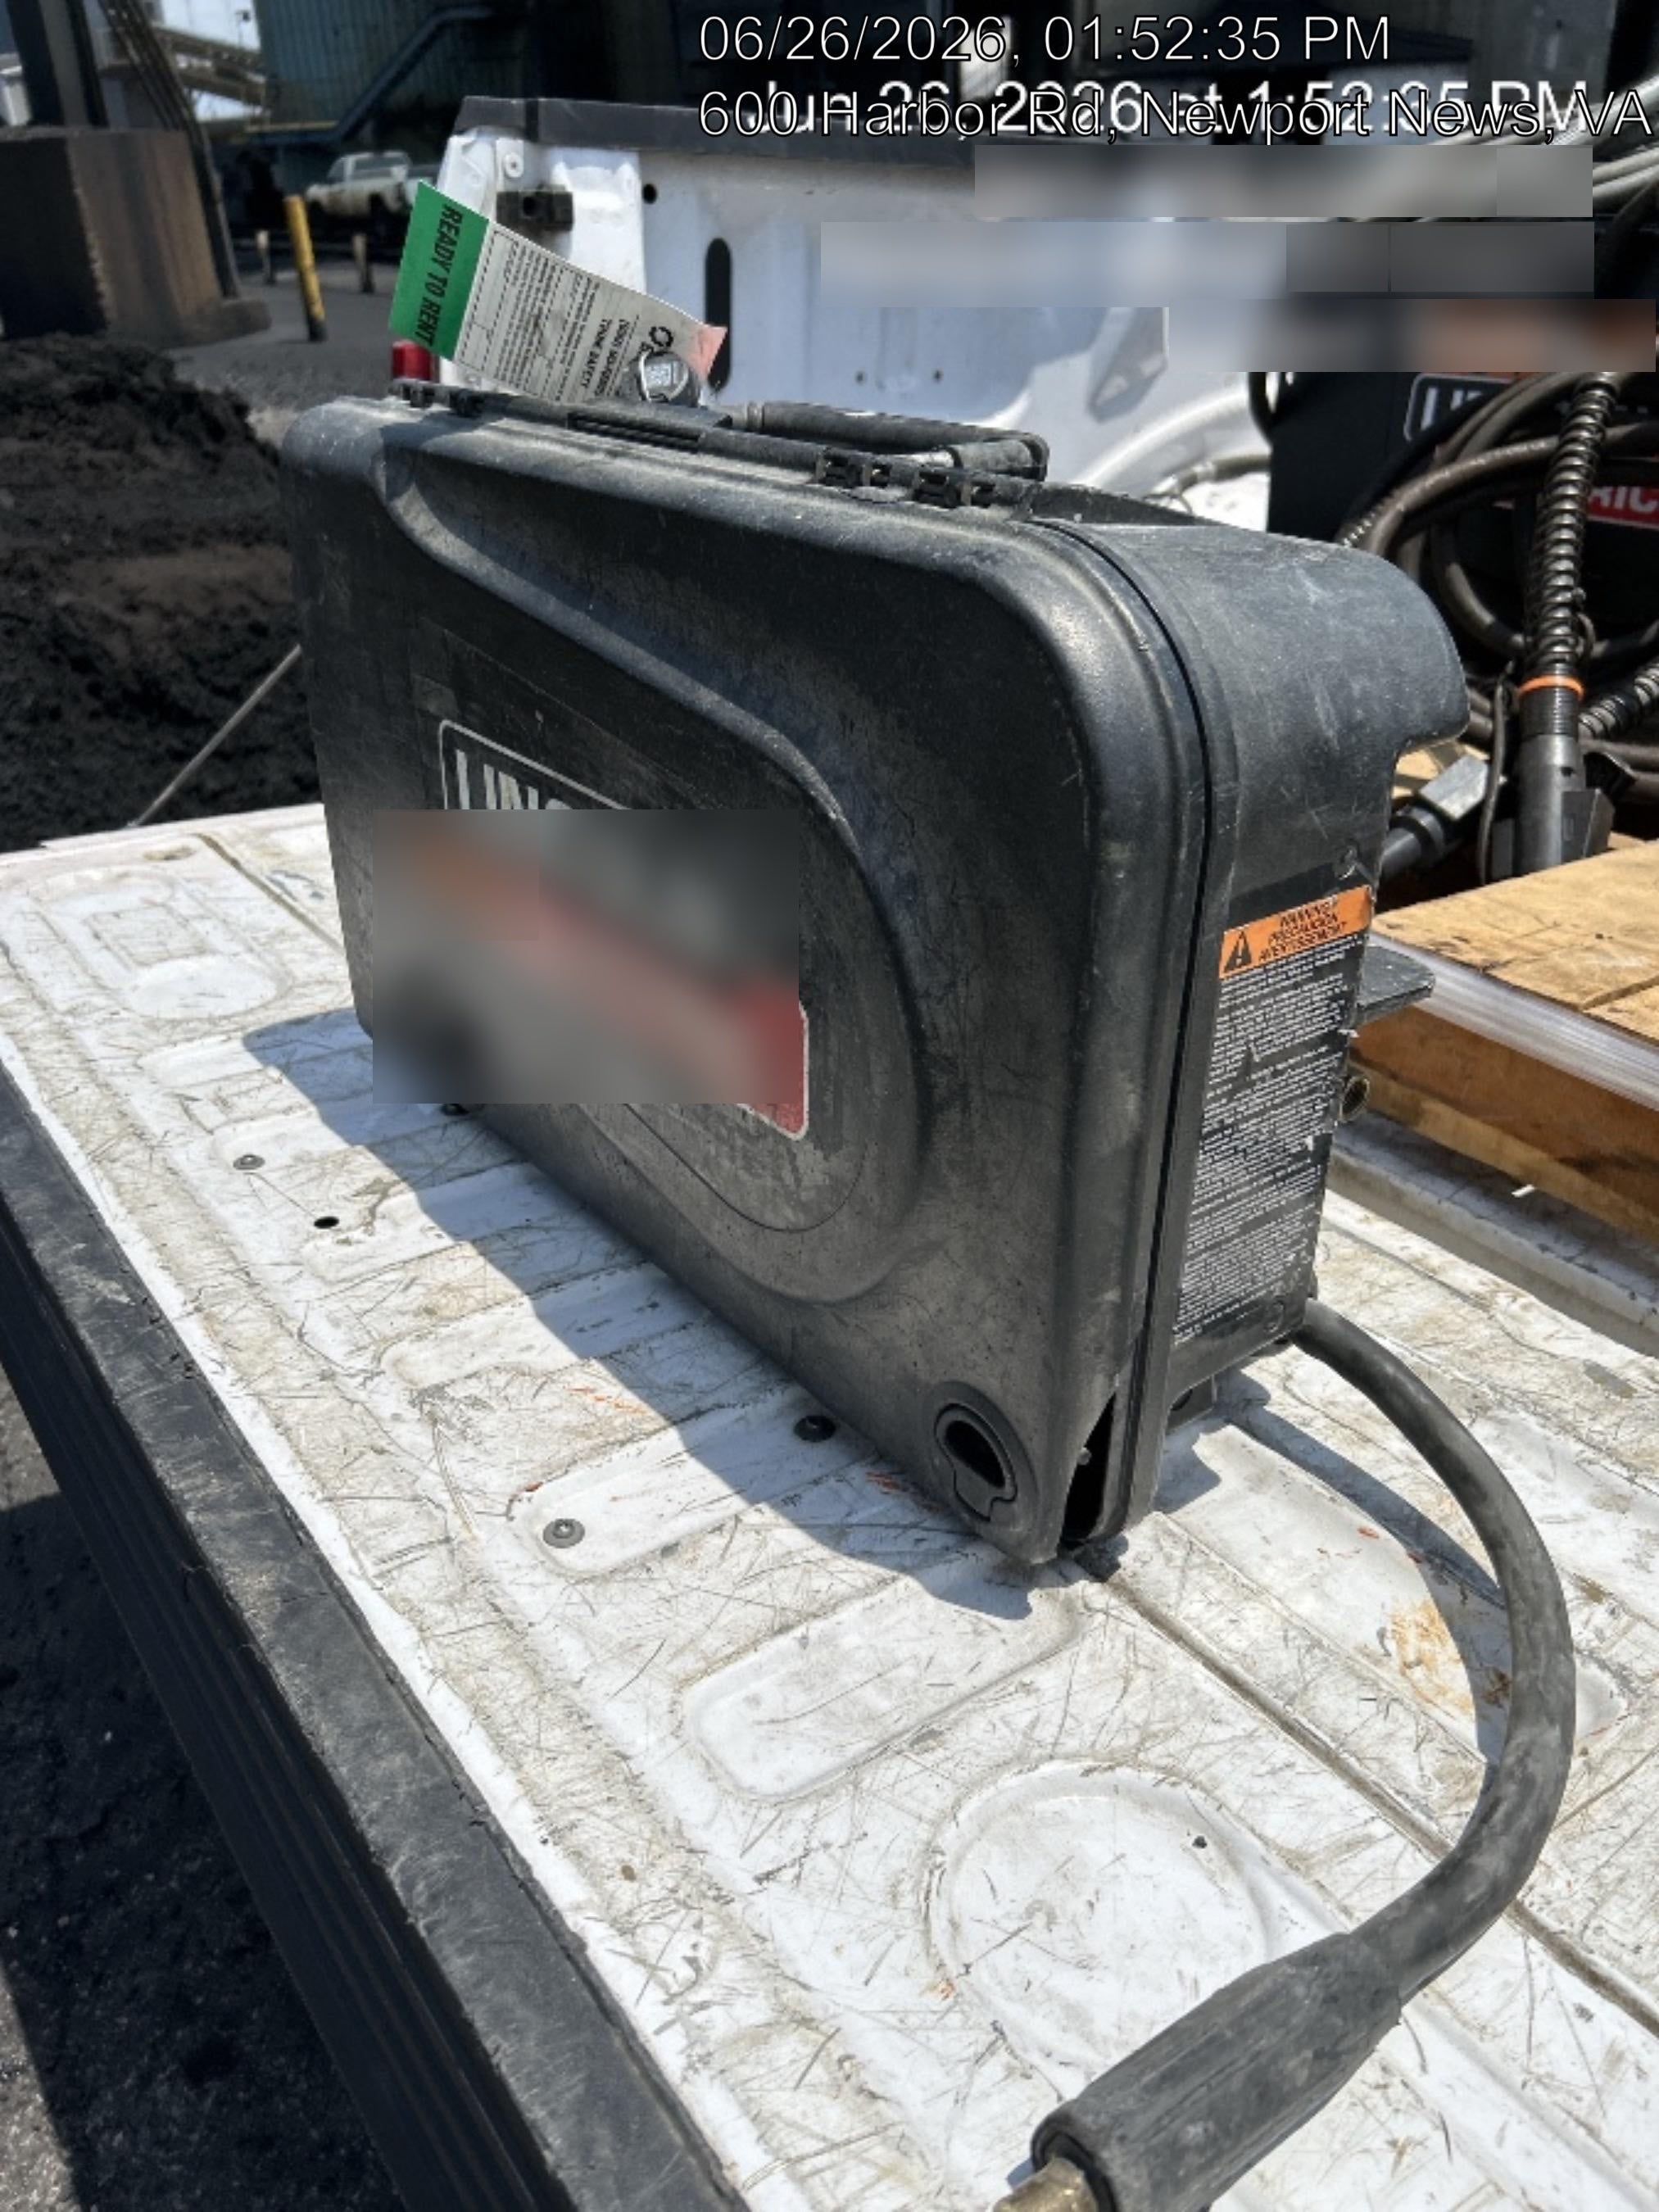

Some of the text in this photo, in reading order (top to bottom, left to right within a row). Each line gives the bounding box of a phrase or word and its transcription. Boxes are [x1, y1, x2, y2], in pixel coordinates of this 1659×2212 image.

[415, 204, 463, 347] READY TO RENT
